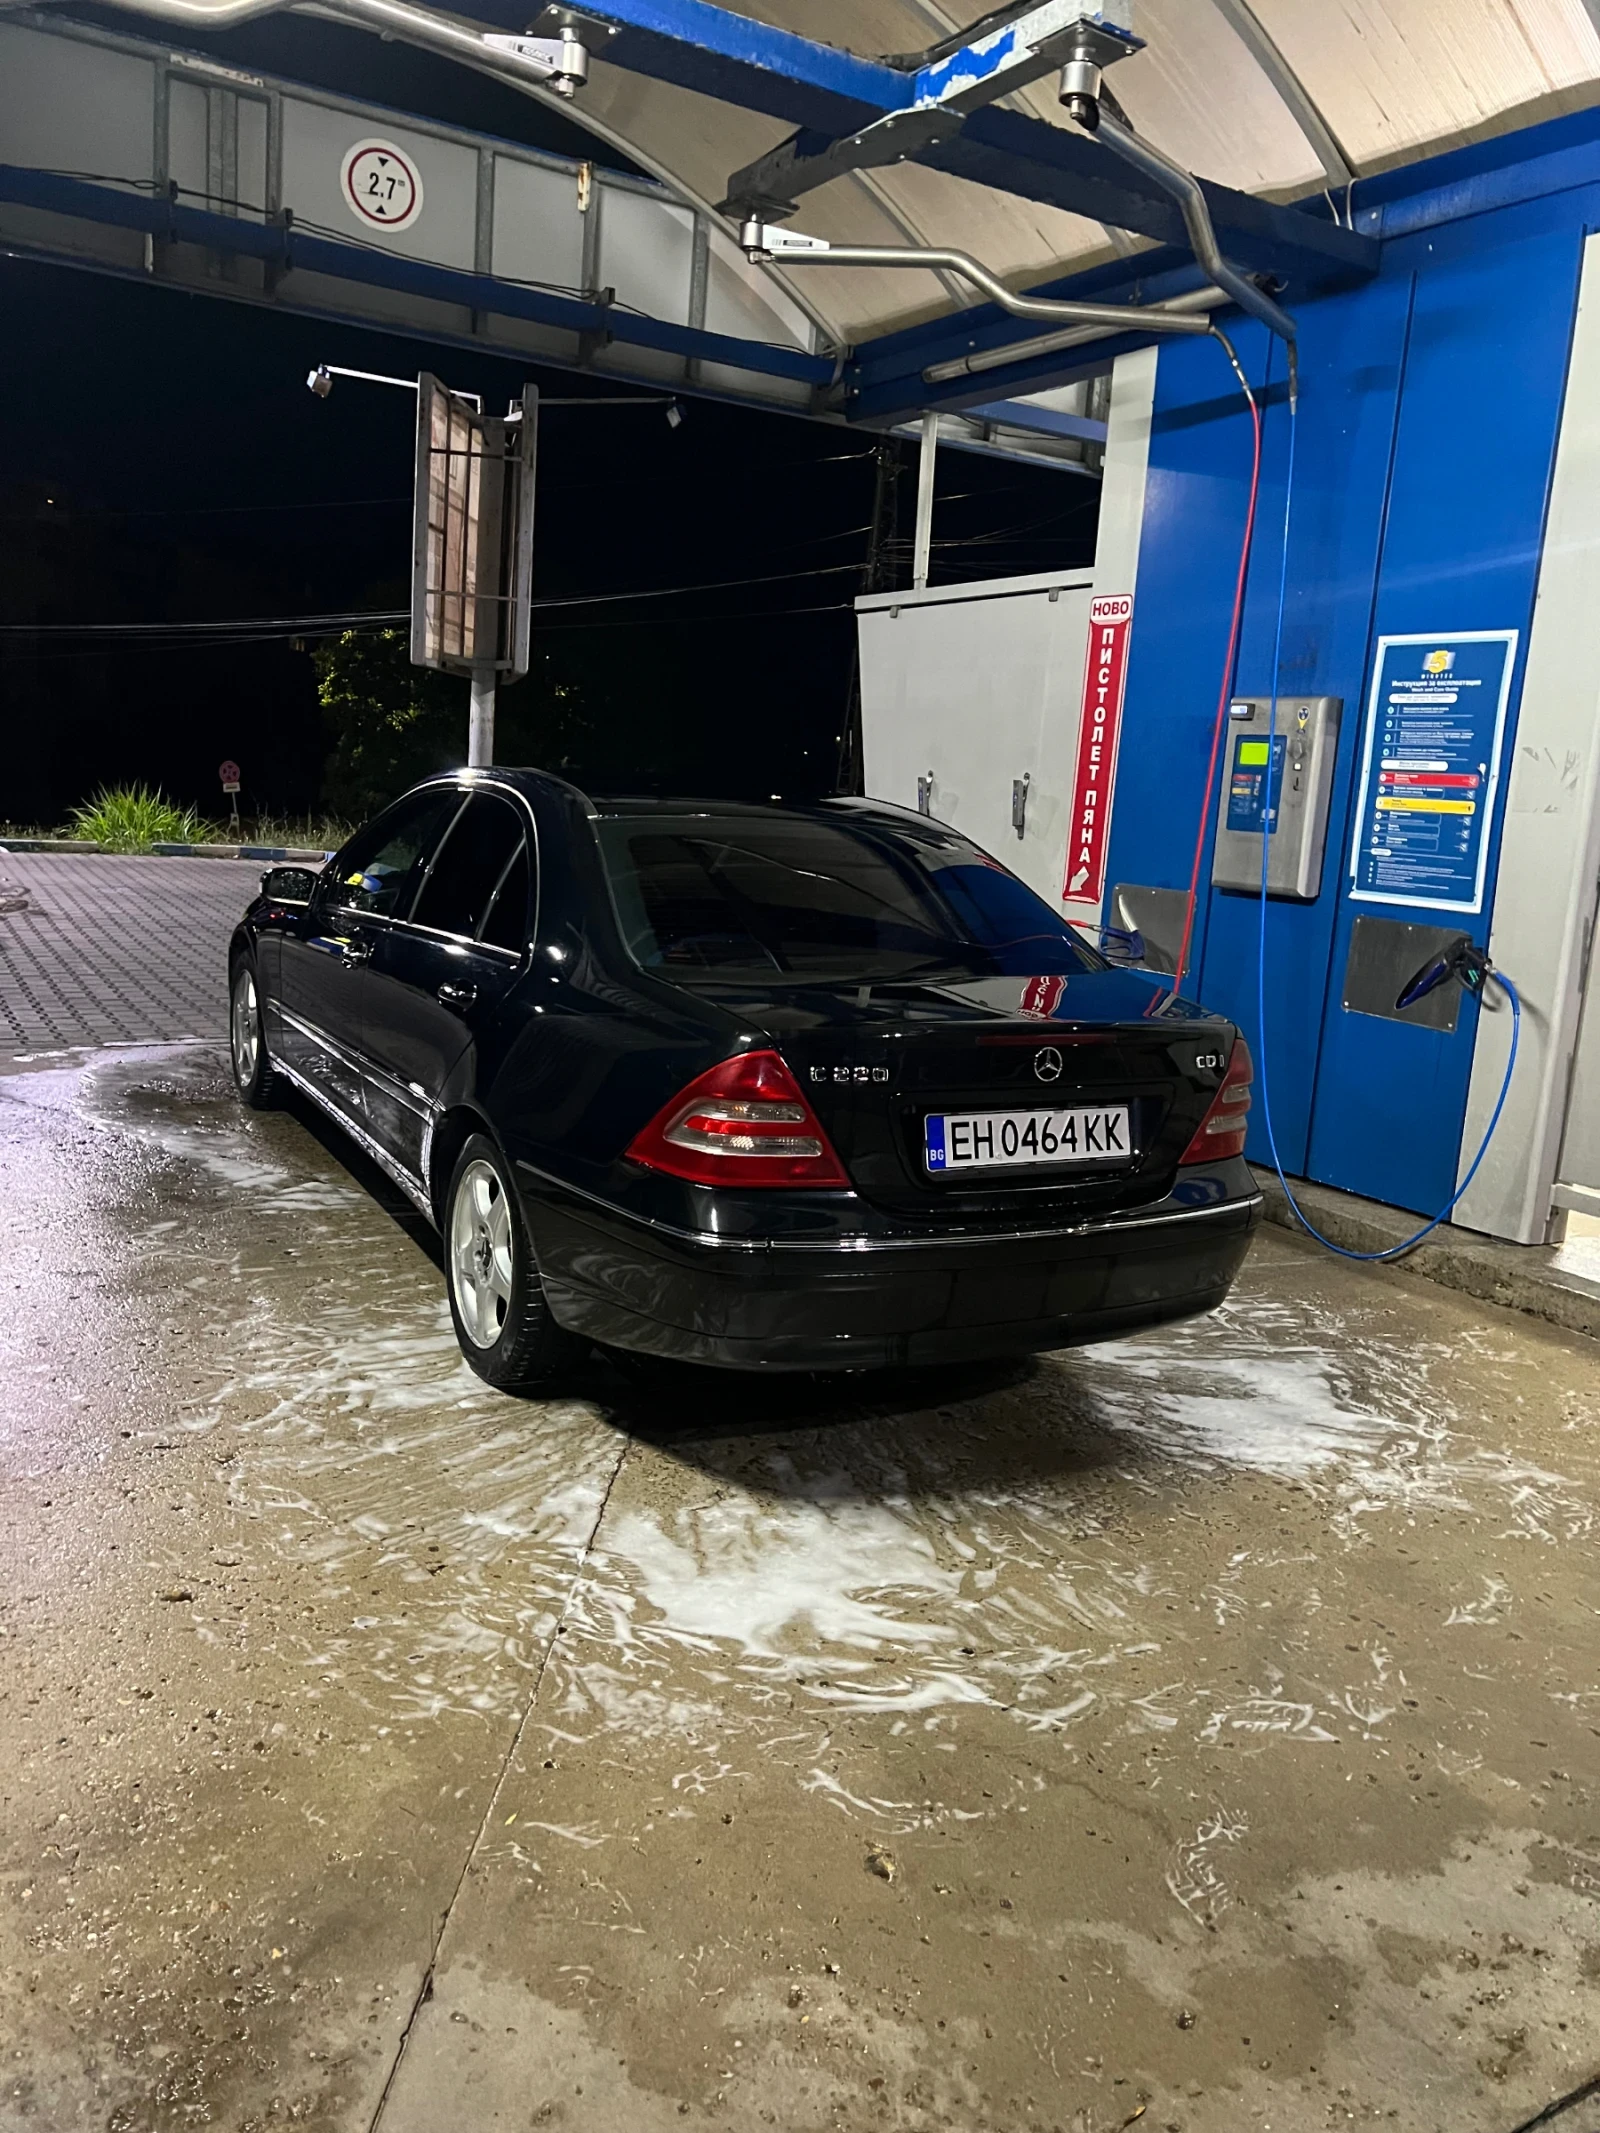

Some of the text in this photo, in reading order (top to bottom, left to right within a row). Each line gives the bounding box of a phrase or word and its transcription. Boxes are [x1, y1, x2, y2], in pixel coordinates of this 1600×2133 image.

[1092, 601, 1130, 616] НОВО
[1079, 628, 1115, 863] ПИСТОЛЕТ ПЯНА
[1196, 1054, 1225, 1068] CDI
[929, 1149, 945, 1161] BG
